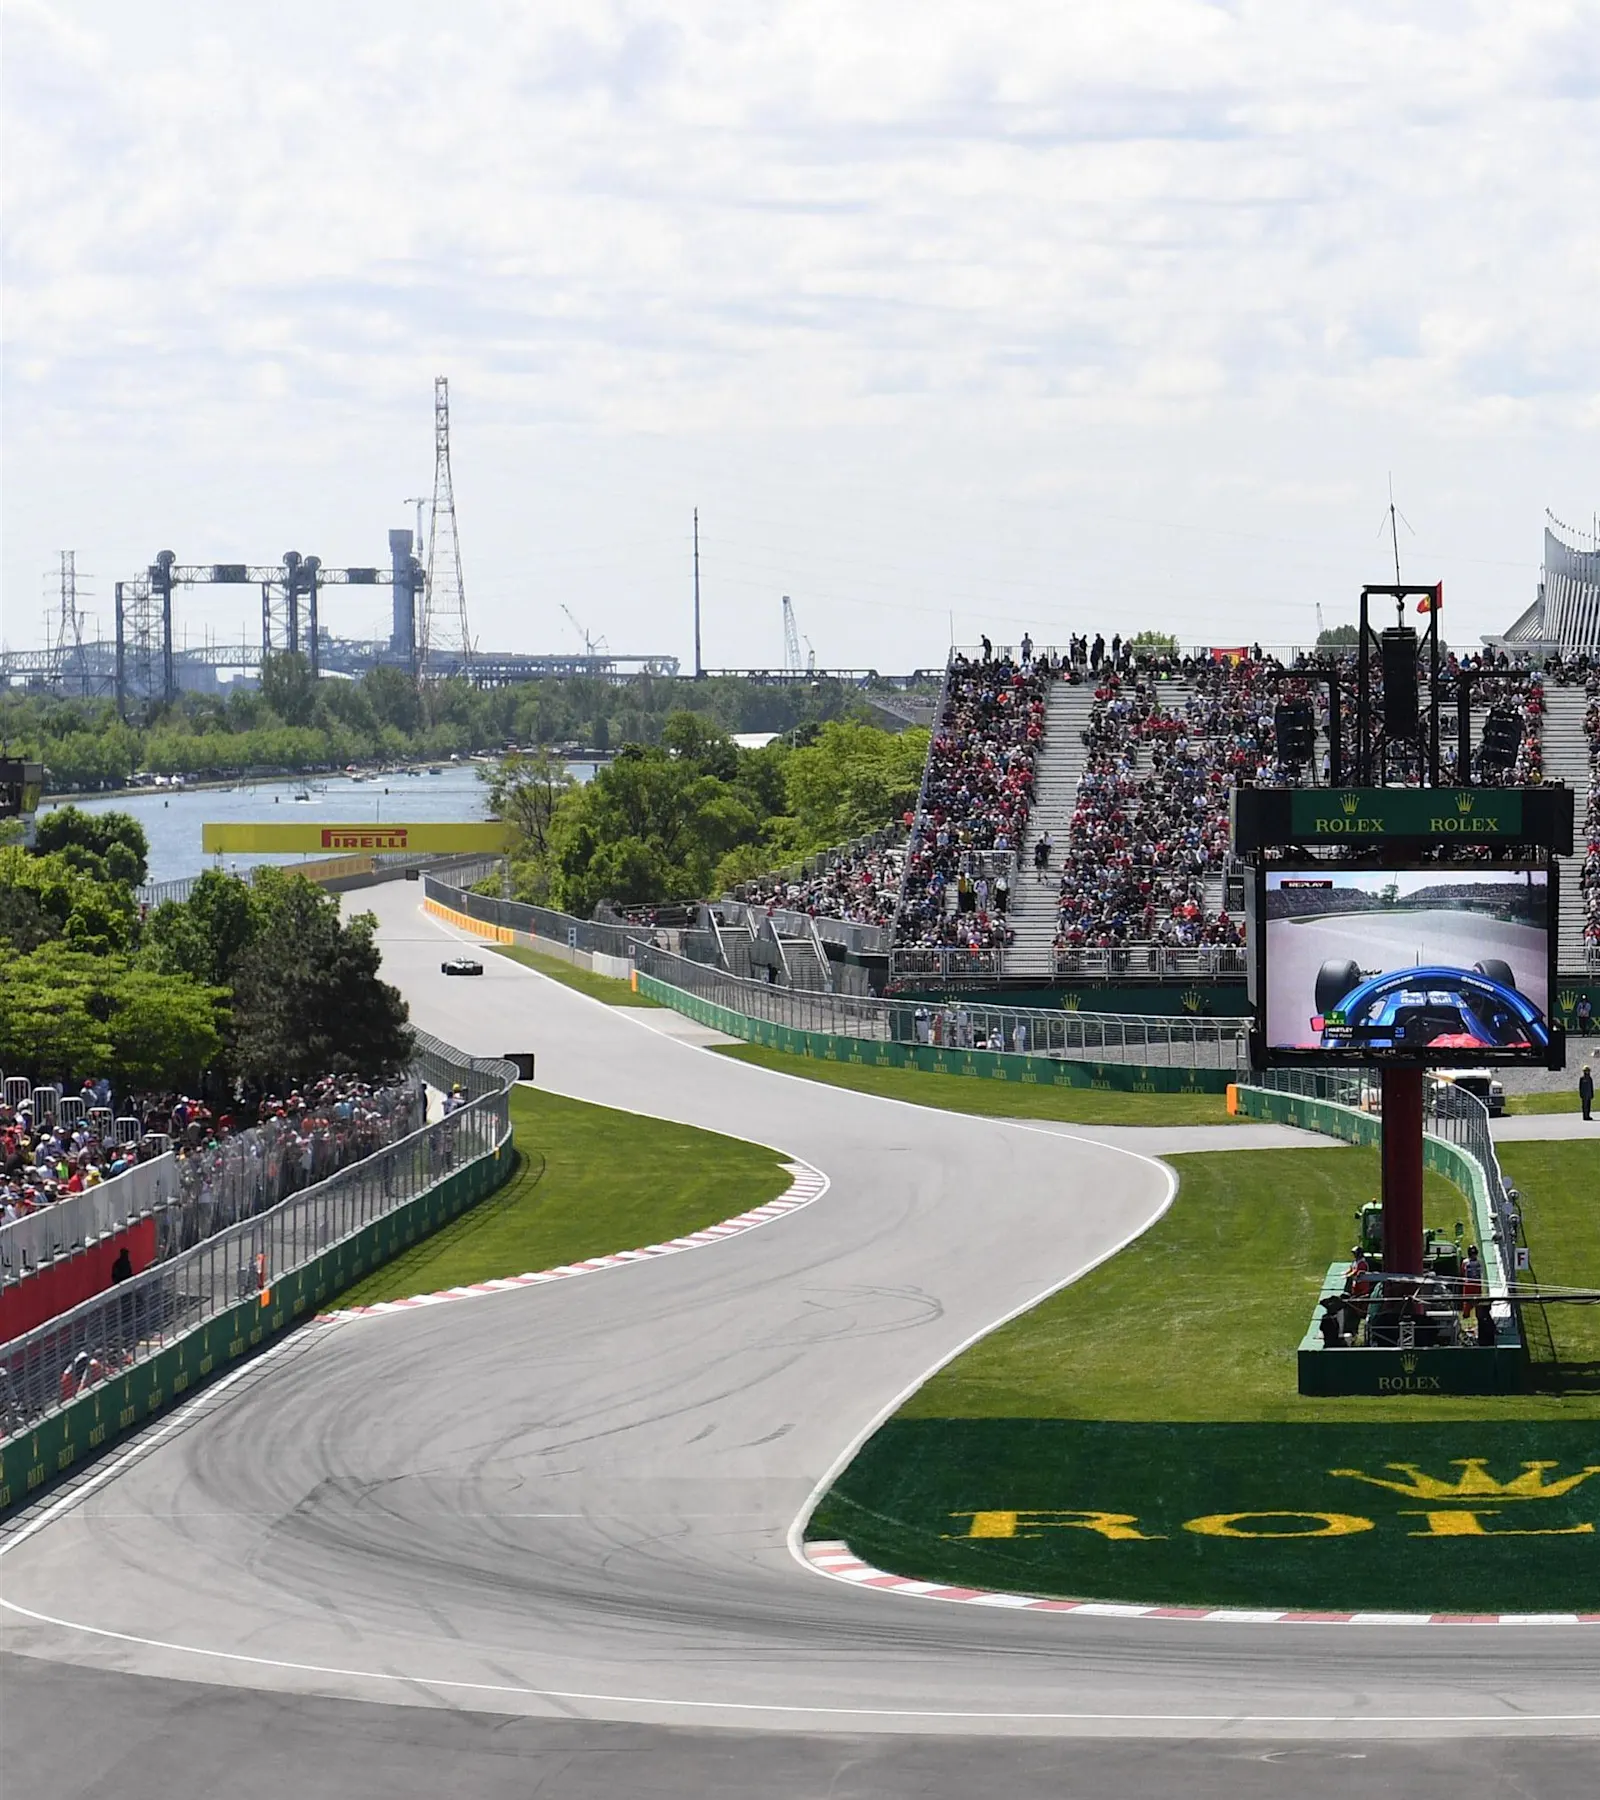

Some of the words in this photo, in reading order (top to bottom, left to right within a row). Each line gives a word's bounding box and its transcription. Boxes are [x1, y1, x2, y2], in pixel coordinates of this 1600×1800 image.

[1315, 818, 1385, 833] ROLEX
[1429, 817, 1499, 832] ROLEX
[321, 829, 408, 848] PIRELLI
[1517, 1252, 1526, 1267] F
[1379, 1376, 1441, 1390] ROLEX
